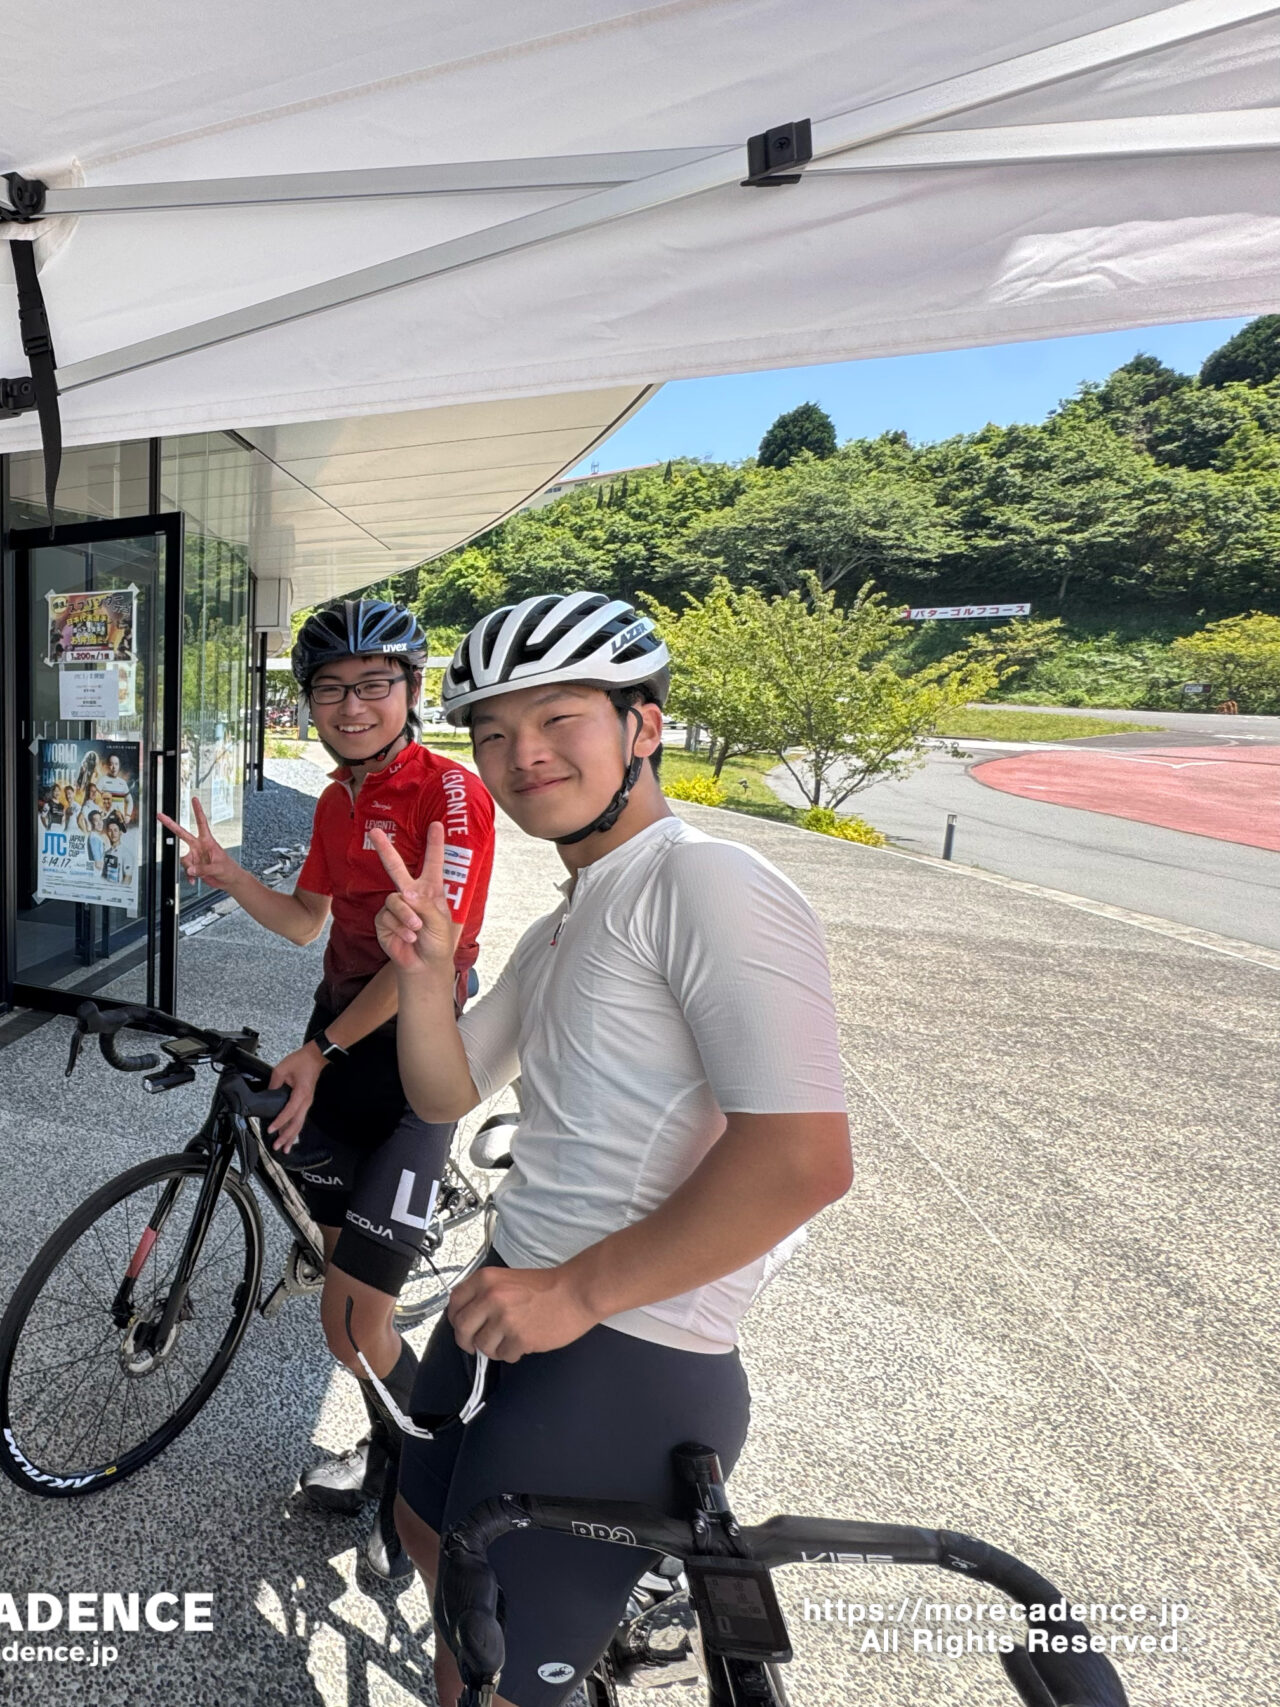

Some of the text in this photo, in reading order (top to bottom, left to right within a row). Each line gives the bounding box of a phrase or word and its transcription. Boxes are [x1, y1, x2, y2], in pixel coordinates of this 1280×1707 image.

[382, 643, 407, 653] uvex
[611, 622, 648, 655] LAZER
[442, 769, 469, 837] LEVANTE
[42, 832, 67, 856] JTC
